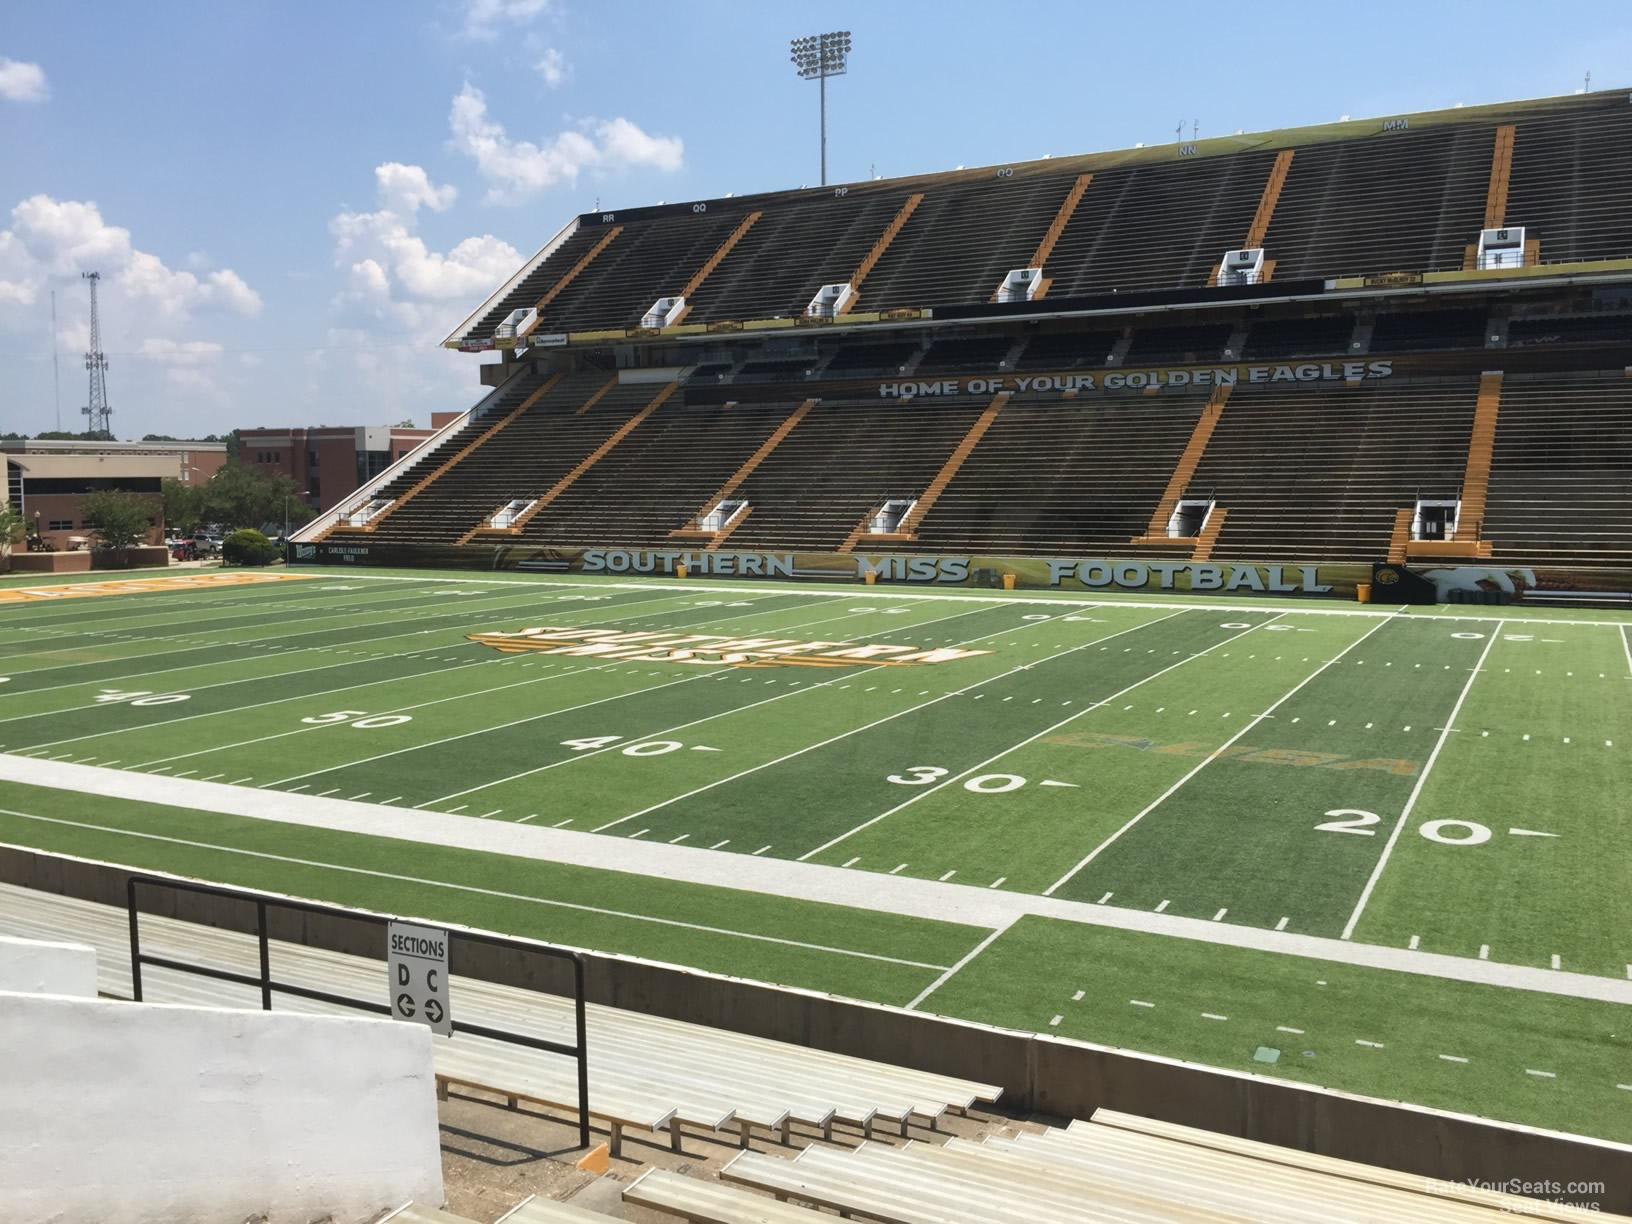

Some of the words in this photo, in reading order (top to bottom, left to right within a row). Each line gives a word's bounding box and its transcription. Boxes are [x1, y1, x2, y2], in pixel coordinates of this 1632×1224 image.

[1383, 119, 1409, 131] MM
[1178, 145, 1197, 156] NN
[835, 188, 848, 197] PP
[692, 203, 707, 214] QQ
[603, 214, 615, 223] RR
[879, 380, 959, 397] HOME
[967, 378, 1004, 394] OF
[1015, 374, 1096, 391] YOUR
[1103, 368, 1238, 389] GOLDEN
[1248, 361, 1393, 383] EAGLES
[582, 550, 794, 577] SOUTHERN
[855, 556, 971, 583] MISS
[1047, 561, 1333, 592] FOOTBALL
[391, 934, 444, 958] SECTIONS
[398, 963, 410, 986] D
[427, 969, 438, 993] C
